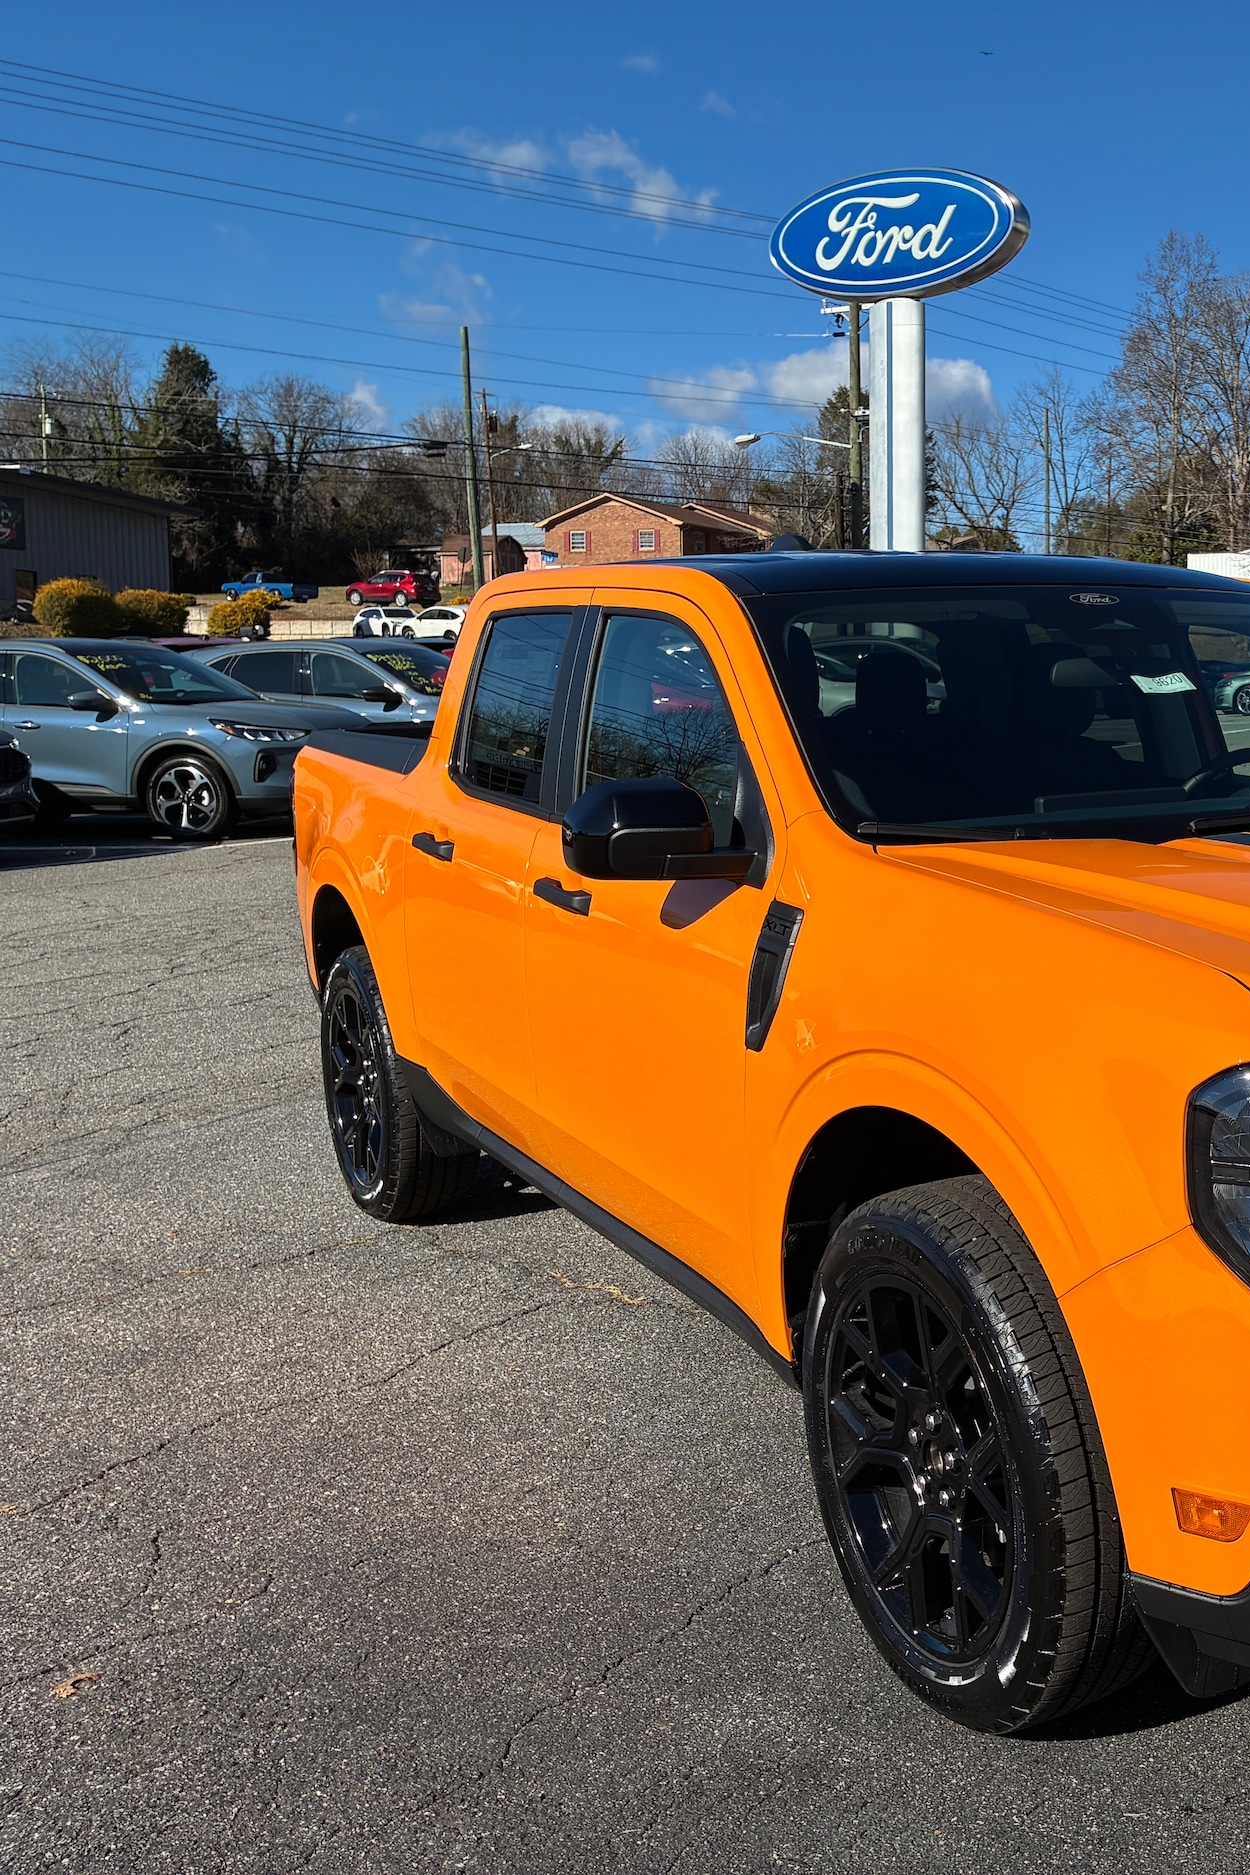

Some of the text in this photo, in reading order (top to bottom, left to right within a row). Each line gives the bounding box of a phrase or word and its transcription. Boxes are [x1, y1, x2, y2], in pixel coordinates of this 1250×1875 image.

[815, 192, 957, 271] Ford
[1080, 594, 1111, 603] Ford
[763, 919, 791, 936] XLT
